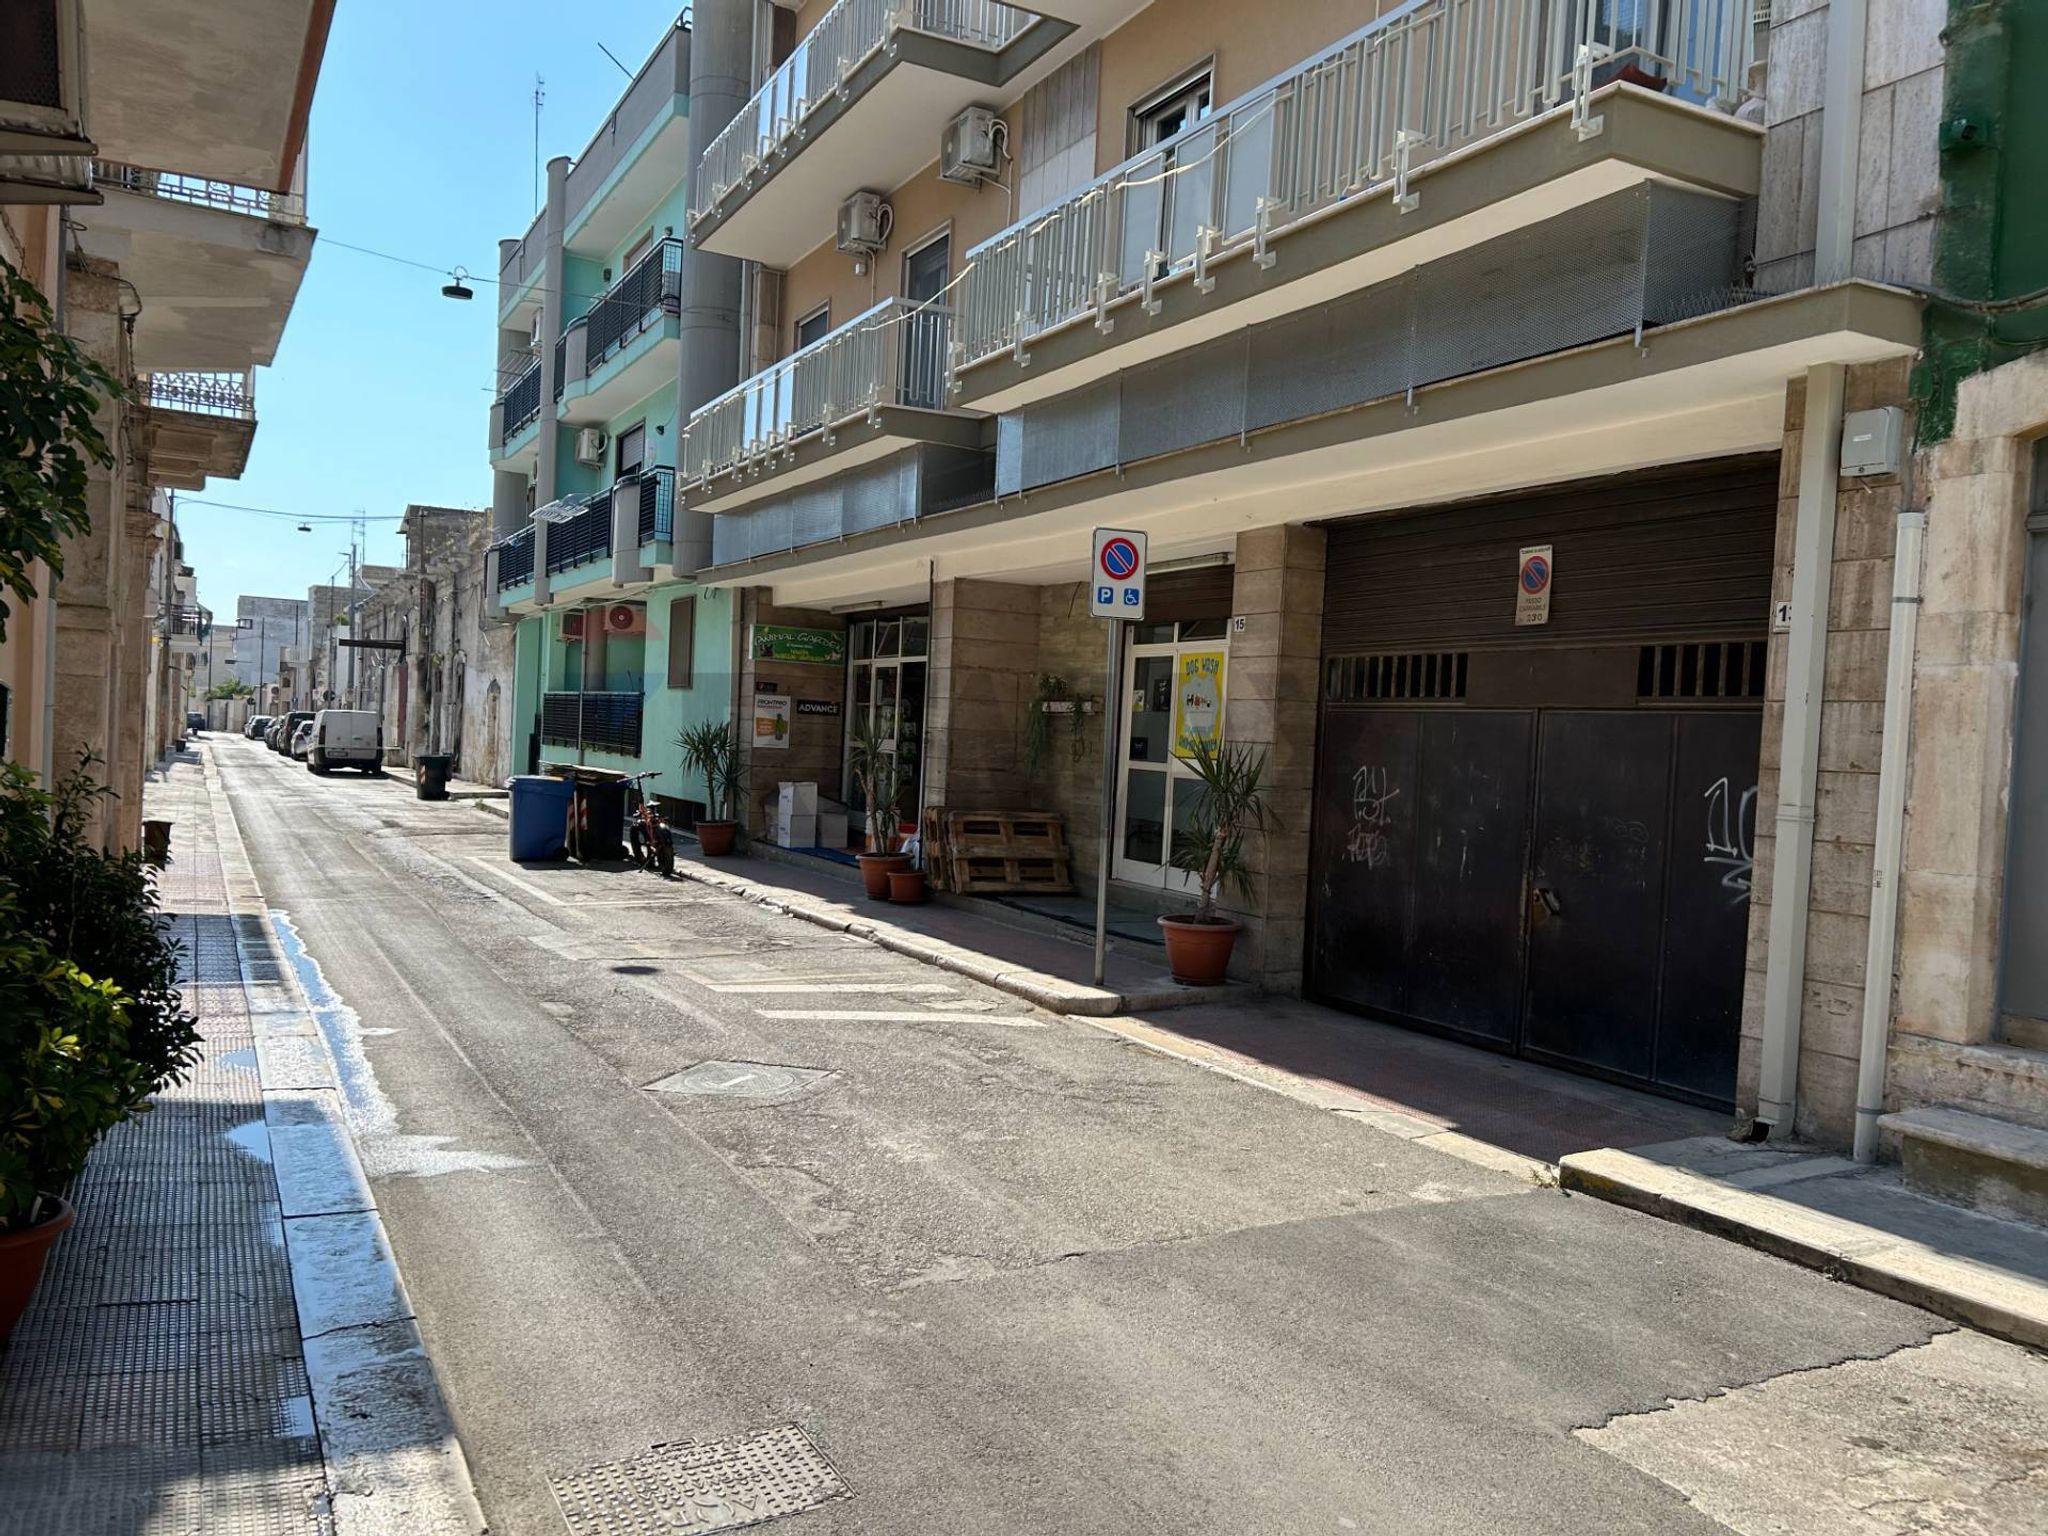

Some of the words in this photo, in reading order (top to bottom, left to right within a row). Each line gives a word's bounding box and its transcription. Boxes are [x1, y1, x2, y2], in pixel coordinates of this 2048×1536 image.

[1101, 589, 1111, 602] P
[1235, 618, 1245, 630] 15
[755, 633, 795, 646] ANIMAL
[797, 632, 844, 653] GARDEN
[1186, 658, 1199, 676] DOG
[1202, 657, 1219, 675] WASH
[798, 704, 839, 714] ADVANCE
